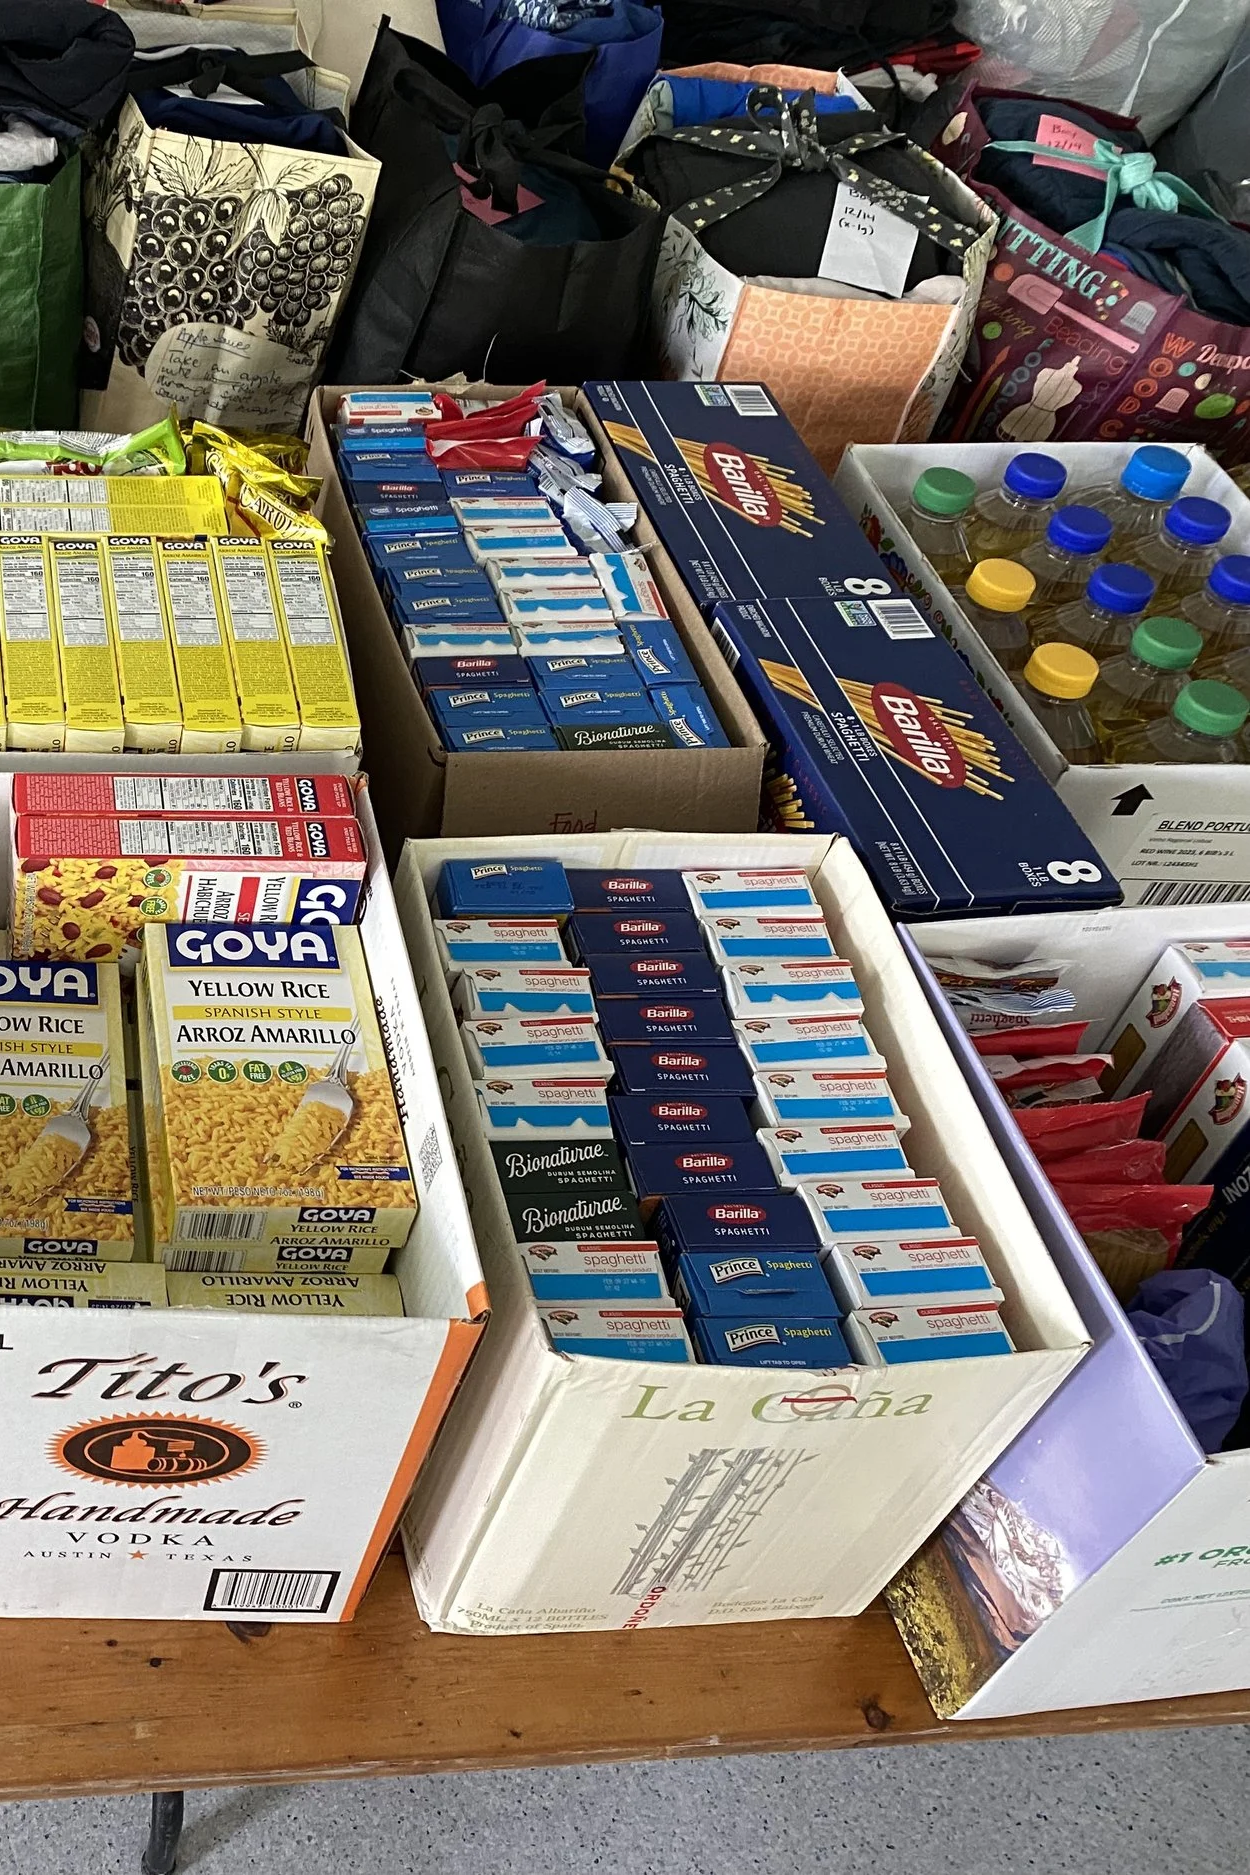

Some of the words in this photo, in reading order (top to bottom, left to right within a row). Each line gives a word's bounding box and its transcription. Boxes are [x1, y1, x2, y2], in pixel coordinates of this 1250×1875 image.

[844, 206, 875, 222] 12/14
[1044, 317, 1129, 376] Beading
[169, 350, 200, 368] Take
[664, 463, 694, 504] SPAGHETTI
[712, 452, 768, 517] Barilla
[395, 503, 439, 514] Spaghetti
[0, 536, 41, 544] GOYA
[219, 537, 260, 545] GOYA
[273, 541, 314, 550] GOYA
[844, 577, 892, 596] 8
[456, 659, 493, 668] Barilla
[451, 692, 490, 704] Prince
[493, 691, 531, 700] Spaghetti
[574, 723, 655, 746] Bionaturae
[831, 712, 870, 762] SPAGHETTI
[879, 693, 951, 775] Barilla
[298, 779, 316, 811] GOYA
[1158, 821, 1204, 830] BLEND
[309, 823, 326, 856] GOYA
[473, 865, 506, 876] Prince
[510, 864, 543, 873] Spaghetti
[1018, 862, 1041, 888] BOXES
[1046, 860, 1102, 885] 8
[608, 880, 648, 890] Barilla
[261, 877, 286, 916] YELLOW
[494, 926, 548, 939] spaghetti
[176, 929, 334, 964] GOYA
[188, 980, 279, 998] YELLOW
[282, 980, 330, 998] RICE
[205, 1006, 268, 1019] SPANISH
[271, 1007, 322, 1019] STYLE
[38, 1015, 84, 1035] RICE
[176, 1024, 246, 1044] ARROZ
[251, 1024, 356, 1046] AMARILLO
[30, 1042, 73, 1054] STYLE
[658, 1056, 701, 1067] Barilla
[0, 1058, 103, 1079] AMARILLO
[249, 1064, 265, 1073] FAT
[250, 1071, 266, 1080] FREE
[657, 1073, 709, 1081] SPAGHETTI
[505, 1143, 605, 1179] Bionaturae
[681, 1156, 726, 1167] Barilla
[557, 1176, 614, 1184] SPAGHETTI
[682, 1174, 737, 1184] SPAGHETTI
[870, 1188, 930, 1202] spaghetti
[302, 1209, 373, 1221] GOYA
[522, 1196, 623, 1235] Bionaturae
[715, 1208, 759, 1219] Barilla
[290, 1224, 344, 1234] YELLOW
[348, 1225, 378, 1233] RICE
[575, 1231, 633, 1239] SPAGHETTI
[714, 1227, 770, 1236] SPAGHETTI
[27, 1240, 94, 1253] GOYA
[270, 1236, 316, 1245] ARROZ
[319, 1237, 390, 1246] AMARILLO
[281, 1248, 349, 1260] GOYA
[714, 1260, 758, 1279] Prince
[766, 1260, 813, 1271] Spaghetti
[202, 1276, 295, 1287] AMARILLO
[300, 1277, 359, 1287] ARROZ
[227, 1294, 266, 1307] RICE
[271, 1294, 345, 1307] YELLOW
[606, 1319, 671, 1332] spaghetti
[927, 1314, 991, 1329] spaghetti
[730, 1326, 774, 1344] Prince
[783, 1327, 832, 1337] Spaghetti
[32, 1352, 310, 1406] Tito's
[622, 1384, 715, 1423] La
[66, 1532, 216, 1546] VODKA
[23, 1550, 112, 1559] AUSTIN
[166, 1553, 254, 1562] TEXAS
